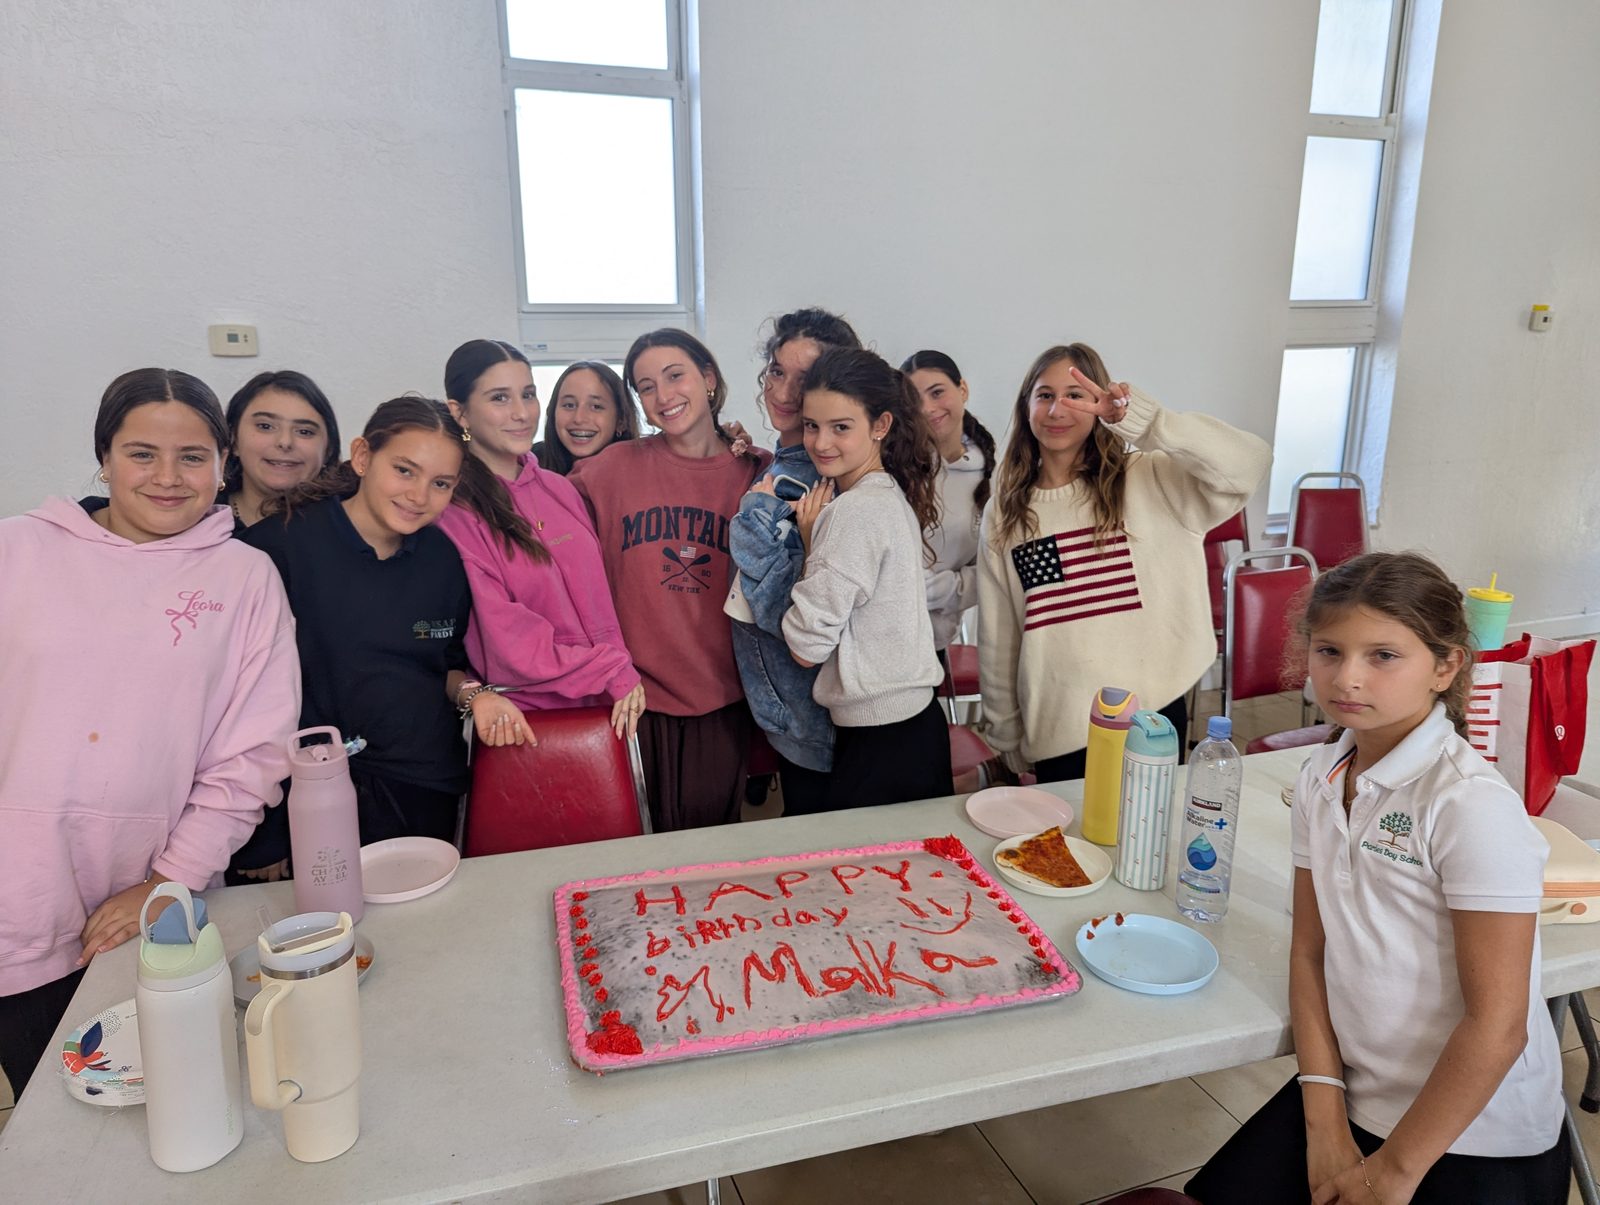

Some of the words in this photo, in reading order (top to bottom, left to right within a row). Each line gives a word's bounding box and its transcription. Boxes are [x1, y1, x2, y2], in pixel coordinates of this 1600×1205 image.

[622, 505, 731, 552] MONTAU
[165, 590, 225, 619] Leora
[1186, 810, 1214, 824] Alkaline
[1186, 816, 1205, 827] Water
[1384, 849, 1397, 861] Day
[635, 860, 911, 915] HAPPY
[743, 933, 998, 1010] Malka
